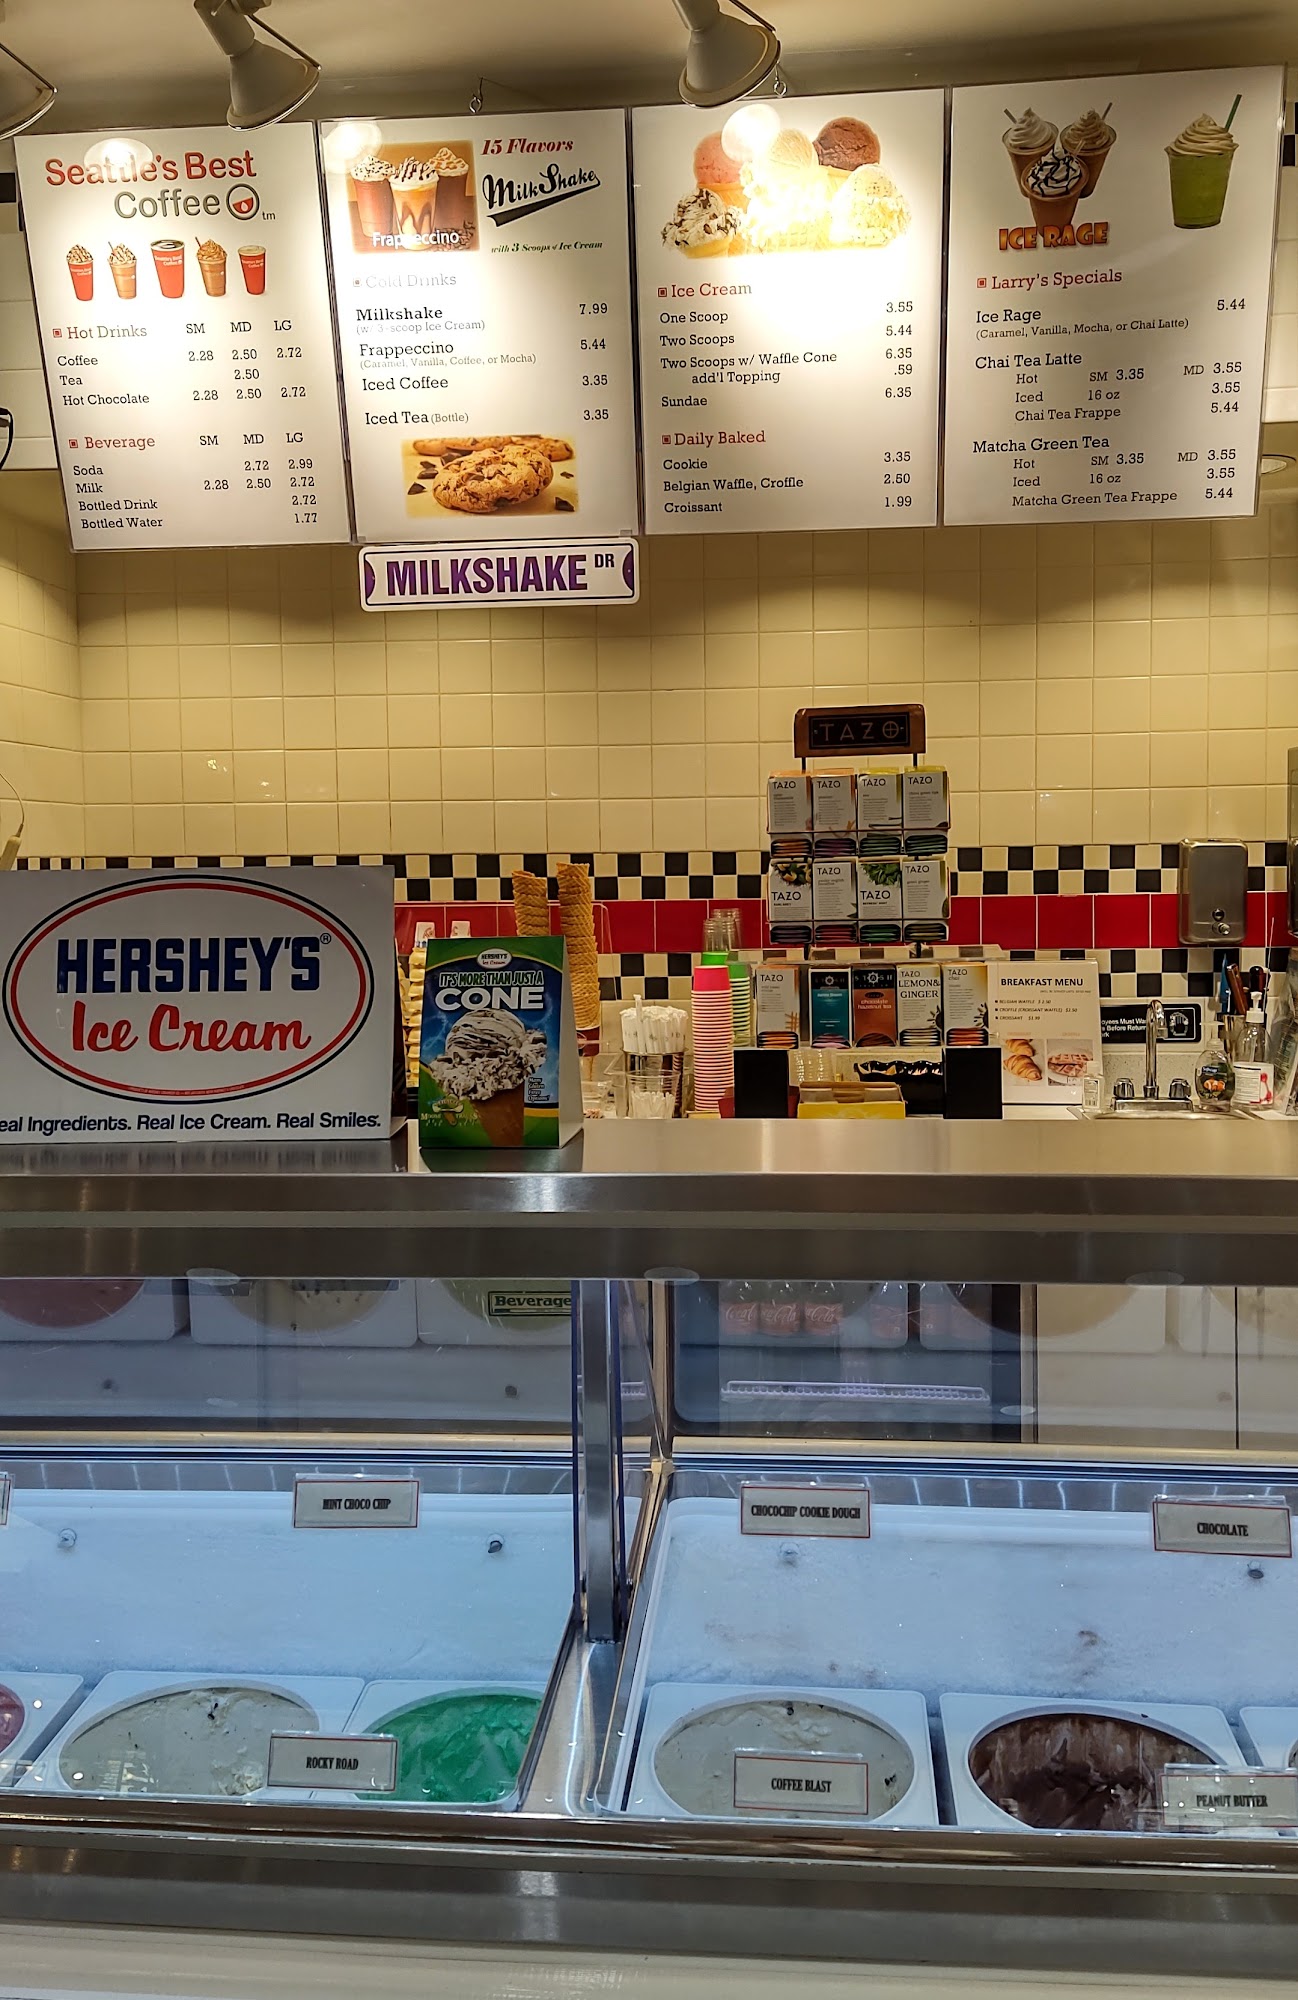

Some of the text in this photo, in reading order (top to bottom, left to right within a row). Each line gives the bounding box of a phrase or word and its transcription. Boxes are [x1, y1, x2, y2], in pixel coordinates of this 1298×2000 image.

[480, 137, 574, 156] 15 Flavors
[45, 150, 257, 186] Seattle's Best
[114, 190, 276, 221] Coffee tm
[999, 222, 1108, 250] ICE RAGE
[511, 242, 521, 253] 3
[521, 243, 551, 255] Scoops
[558, 242, 572, 252] Ice
[573, 241, 603, 250] Cream
[992, 269, 1123, 291] Larry's Specials
[671, 282, 752, 298] Ice Cream
[356, 303, 609, 322] Milkshake 7.99
[659, 301, 914, 325] One Scoop 3.55
[975, 298, 1246, 324] Ice Rage 5.44
[67, 320, 292, 341] Hot Drinks SM MD LG
[975, 317, 1189, 340] (Caramel, Vanilla, Mocha, or Chai Latte)
[57, 347, 302, 367] Coffee 2.28 2.50 2.72
[360, 339, 607, 359] Frappeccino 5.44
[660, 347, 913, 370] Two Scoops w/ Waffle Cone 6.35
[974, 352, 1083, 370] Chai Tea Latte
[691, 364, 913, 385] add'l Topping .59
[365, 408, 610, 426] Iced Tea (Bottle) 3.35
[84, 432, 304, 452] Beverage SM MD LG
[674, 430, 766, 449] Daily Baked
[972, 436, 1110, 454] Matcha Green Tea
[73, 458, 313, 477] Soda 2.72 2.99
[663, 451, 911, 471] Cookie 3.35
[663, 479, 710, 494] Belgian
[712, 478, 757, 492] Waffle,
[760, 476, 805, 490] Croffle
[1012, 487, 1234, 507] Matcha Green Tea Frappe 5.44
[81, 512, 318, 530] Bottled Water 1.77
[386, 554, 615, 596] MILKSHAKE DR
[819, 721, 899, 741] TAZO
[772, 780, 797, 790] TAZO
[816, 780, 841, 789] TAZO
[862, 778, 887, 788] TAZO
[908, 776, 933, 785] TAZO
[816, 866, 841, 876] TAZO
[905, 865, 930, 874] TAZO
[771, 891, 802, 901] TAZO
[859, 889, 891, 900] TAZO
[56, 936, 320, 994] HERSHEY'S
[439, 970, 544, 987] IT'S MORE THAN JUST A
[760, 974, 784, 982] TAZO
[1000, 978, 1084, 986] BREAKFAST MENU
[435, 986, 544, 1011] CONE
[900, 990, 939, 999] GINGER
[72, 1000, 311, 1052] Ice Cream
[0, 1112, 381, 1136] eal Ingredients. Real Ice Cream. Real Smiles.
[322, 1499, 392, 1509] MINT CHOCO CHIP
[751, 1504, 861, 1519] CHOCOCHIP COOKIE DOUGH
[1197, 1522, 1249, 1537] CHOCOLATE
[306, 1757, 359, 1770] ROCKY ROAD
[771, 1778, 832, 1793] COFFEE BLAST
[1196, 1795, 1268, 1808] PEANUT BUTTER
